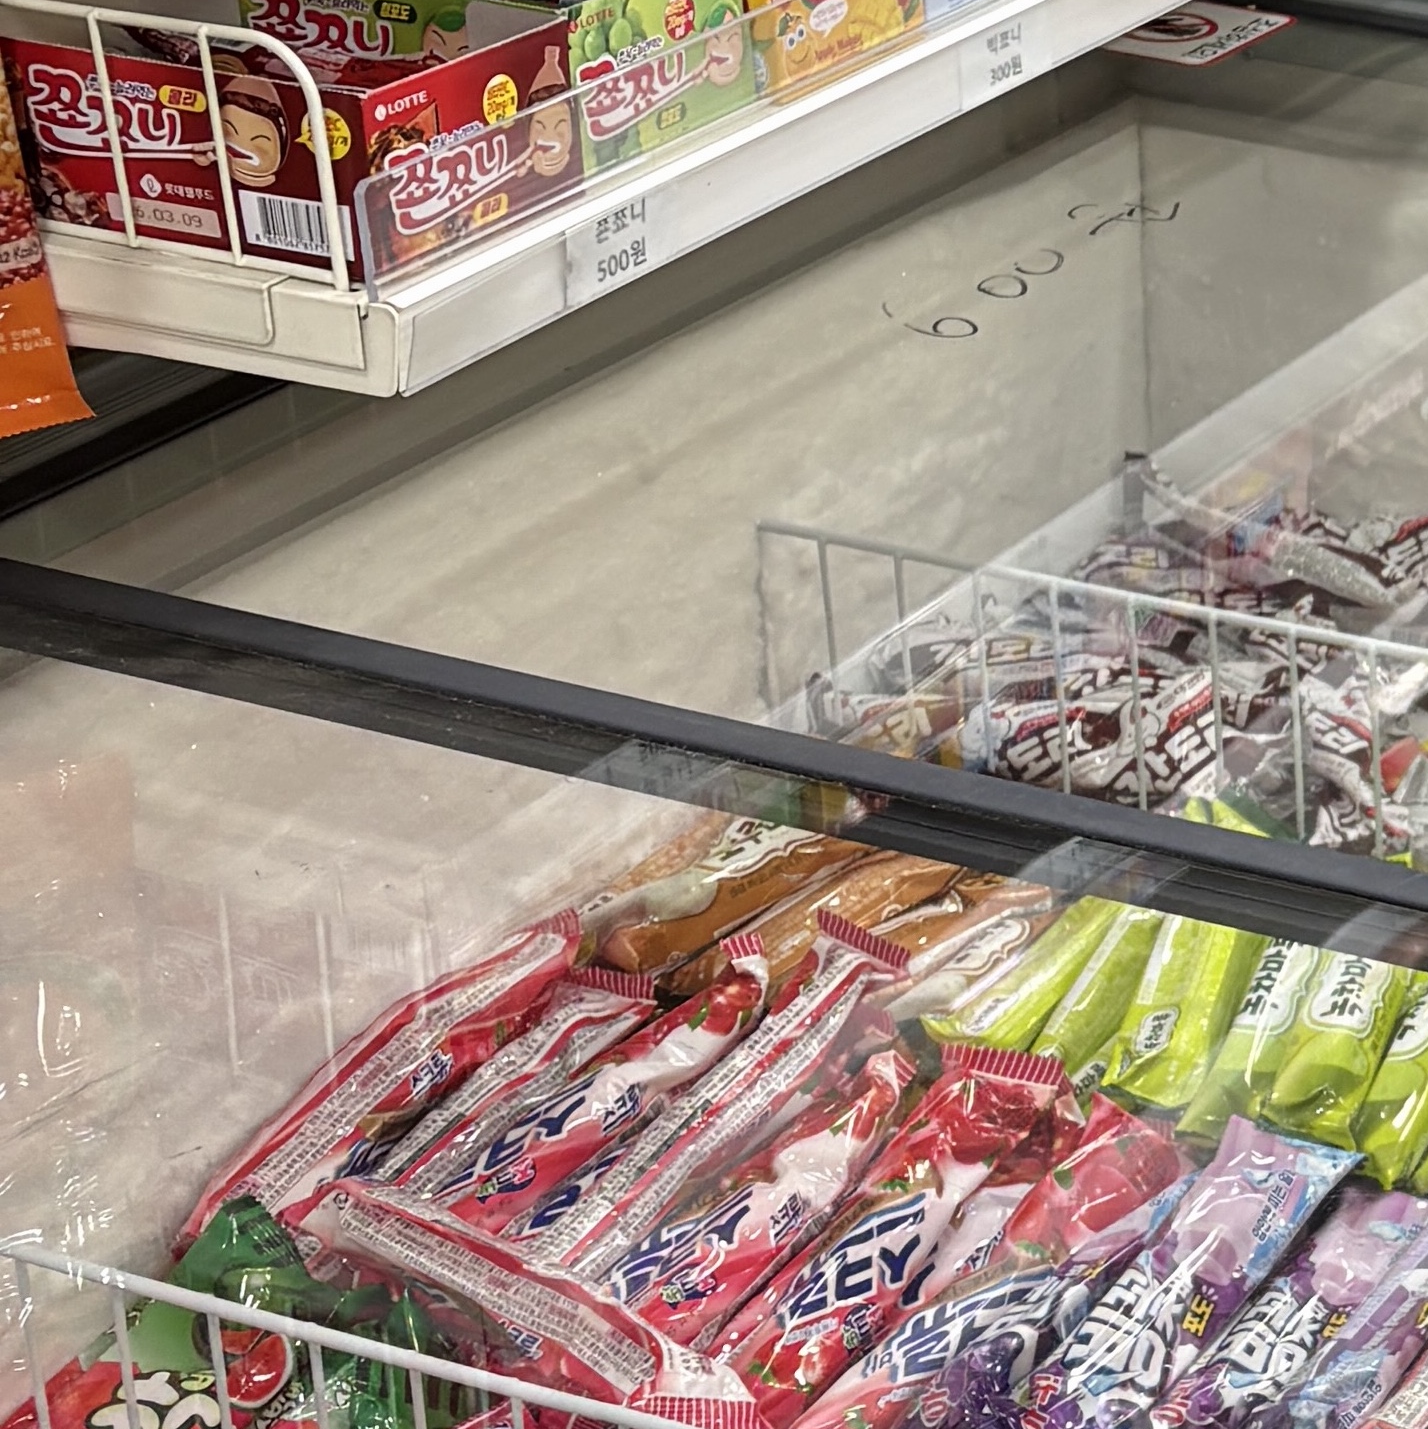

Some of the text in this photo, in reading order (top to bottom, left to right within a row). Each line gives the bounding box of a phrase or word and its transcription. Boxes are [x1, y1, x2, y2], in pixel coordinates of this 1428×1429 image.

[580, 8, 615, 29] LOTTE
[167, 88, 197, 109] 콜라
[387, 91, 429, 116] LOTTE
[164, 183, 215, 201] 롯데웰푸드
[597, 236, 648, 283] 500원
[1183, 1293, 1214, 1339] 포도
